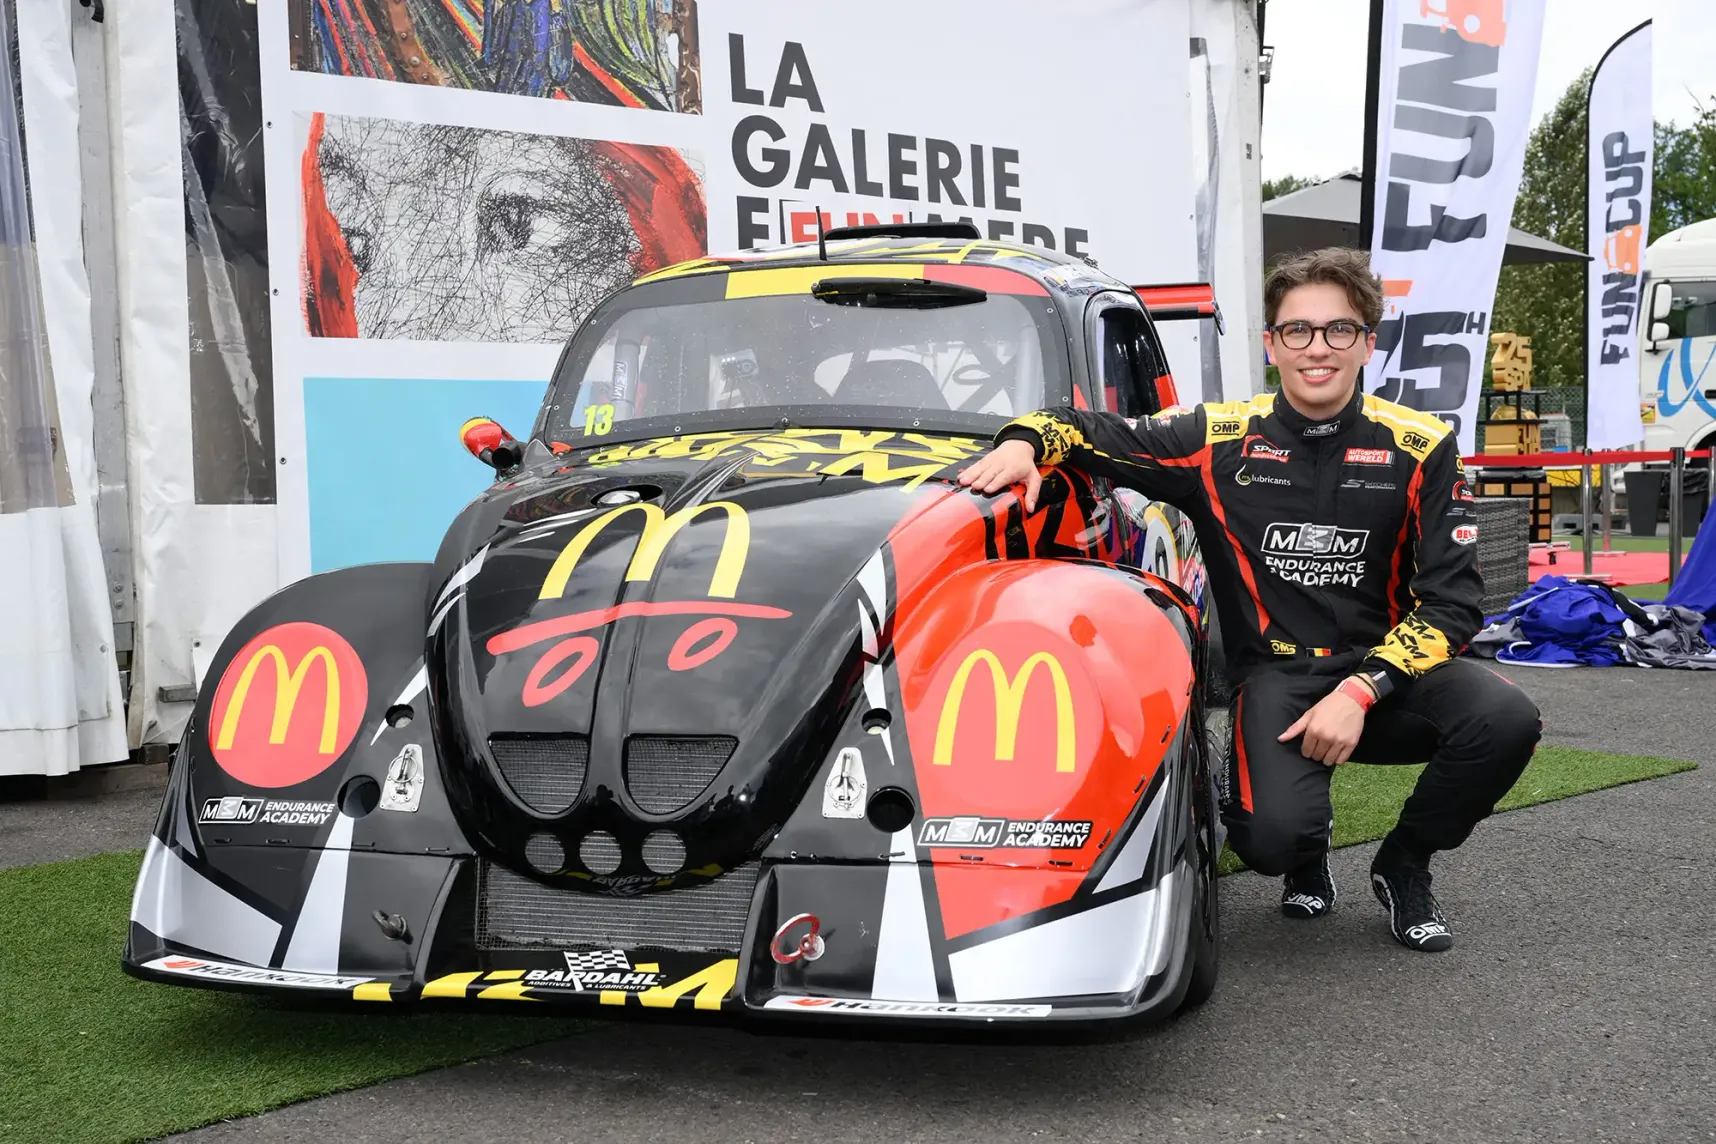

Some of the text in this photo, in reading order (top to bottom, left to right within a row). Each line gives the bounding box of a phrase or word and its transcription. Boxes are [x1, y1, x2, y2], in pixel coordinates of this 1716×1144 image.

[728, 33, 825, 113] LA
[1381, 23, 1500, 252] FUN
[731, 115, 1022, 212] GALERIE
[1600, 131, 1647, 365] FUN CUP
[584, 404, 615, 436] 13
[1211, 423, 1240, 433] OMP
[1402, 433, 1429, 450] OMP
[1251, 474, 1292, 486] lubricants
[1265, 556, 1366, 574] ENDURANCE
[264, 801, 336, 813] ENDURANCE
[259, 812, 332, 824] ACADEMY
[1006, 822, 1092, 834] ENDURANCE
[1002, 833, 1088, 847] ACADEMY
[524, 969, 660, 985] BARDAHL
[527, 980, 572, 988] ADDITIVES
